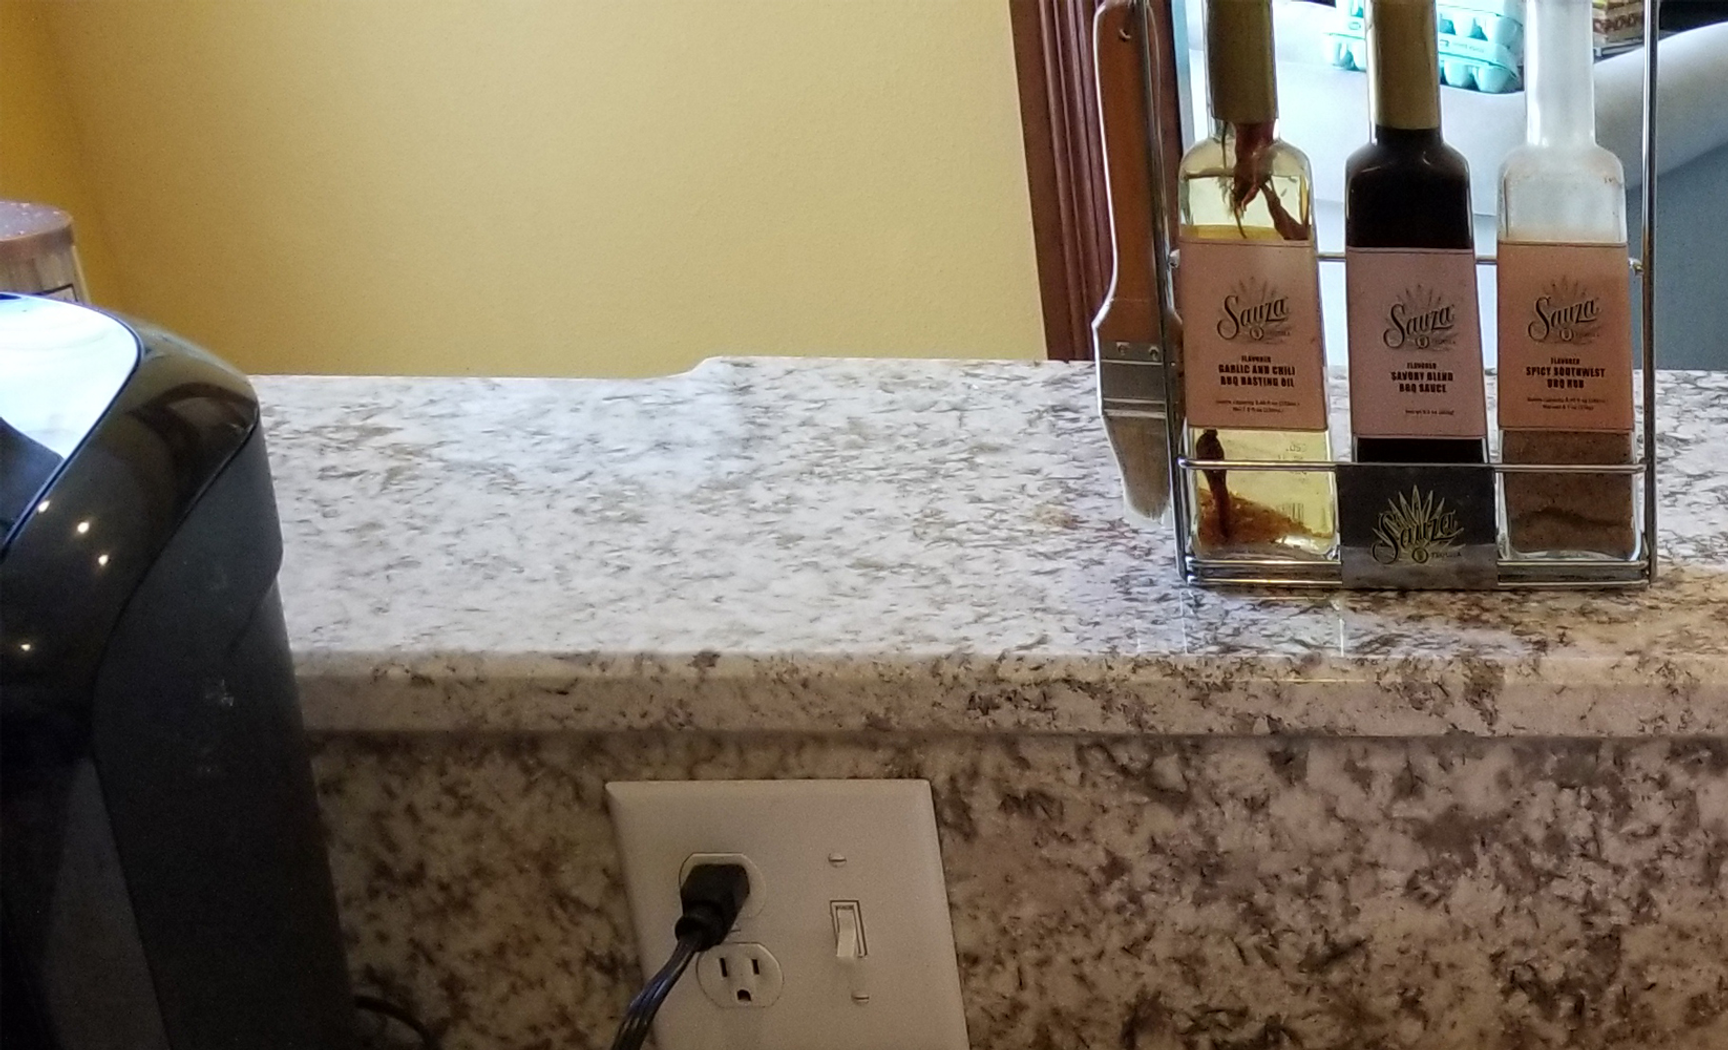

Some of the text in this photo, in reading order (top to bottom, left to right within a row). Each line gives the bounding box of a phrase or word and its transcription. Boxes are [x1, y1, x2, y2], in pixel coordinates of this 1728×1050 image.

[1217, 295, 1290, 340] Sauza
[1528, 296, 1600, 342] Sauza
[1383, 303, 1456, 349] Sauza
[1218, 364, 1296, 376] GARLIC AND CHILI
[1526, 366, 1606, 378] SPICY SOUTHWEST
[1220, 376, 1295, 388] BBQ BASTING OIL
[1390, 371, 1454, 382] SAVORY BLEND
[1399, 383, 1447, 393] BBQ SAUCE
[1547, 378, 1565, 389] BBQ
[1371, 510, 1463, 565] Sauza
